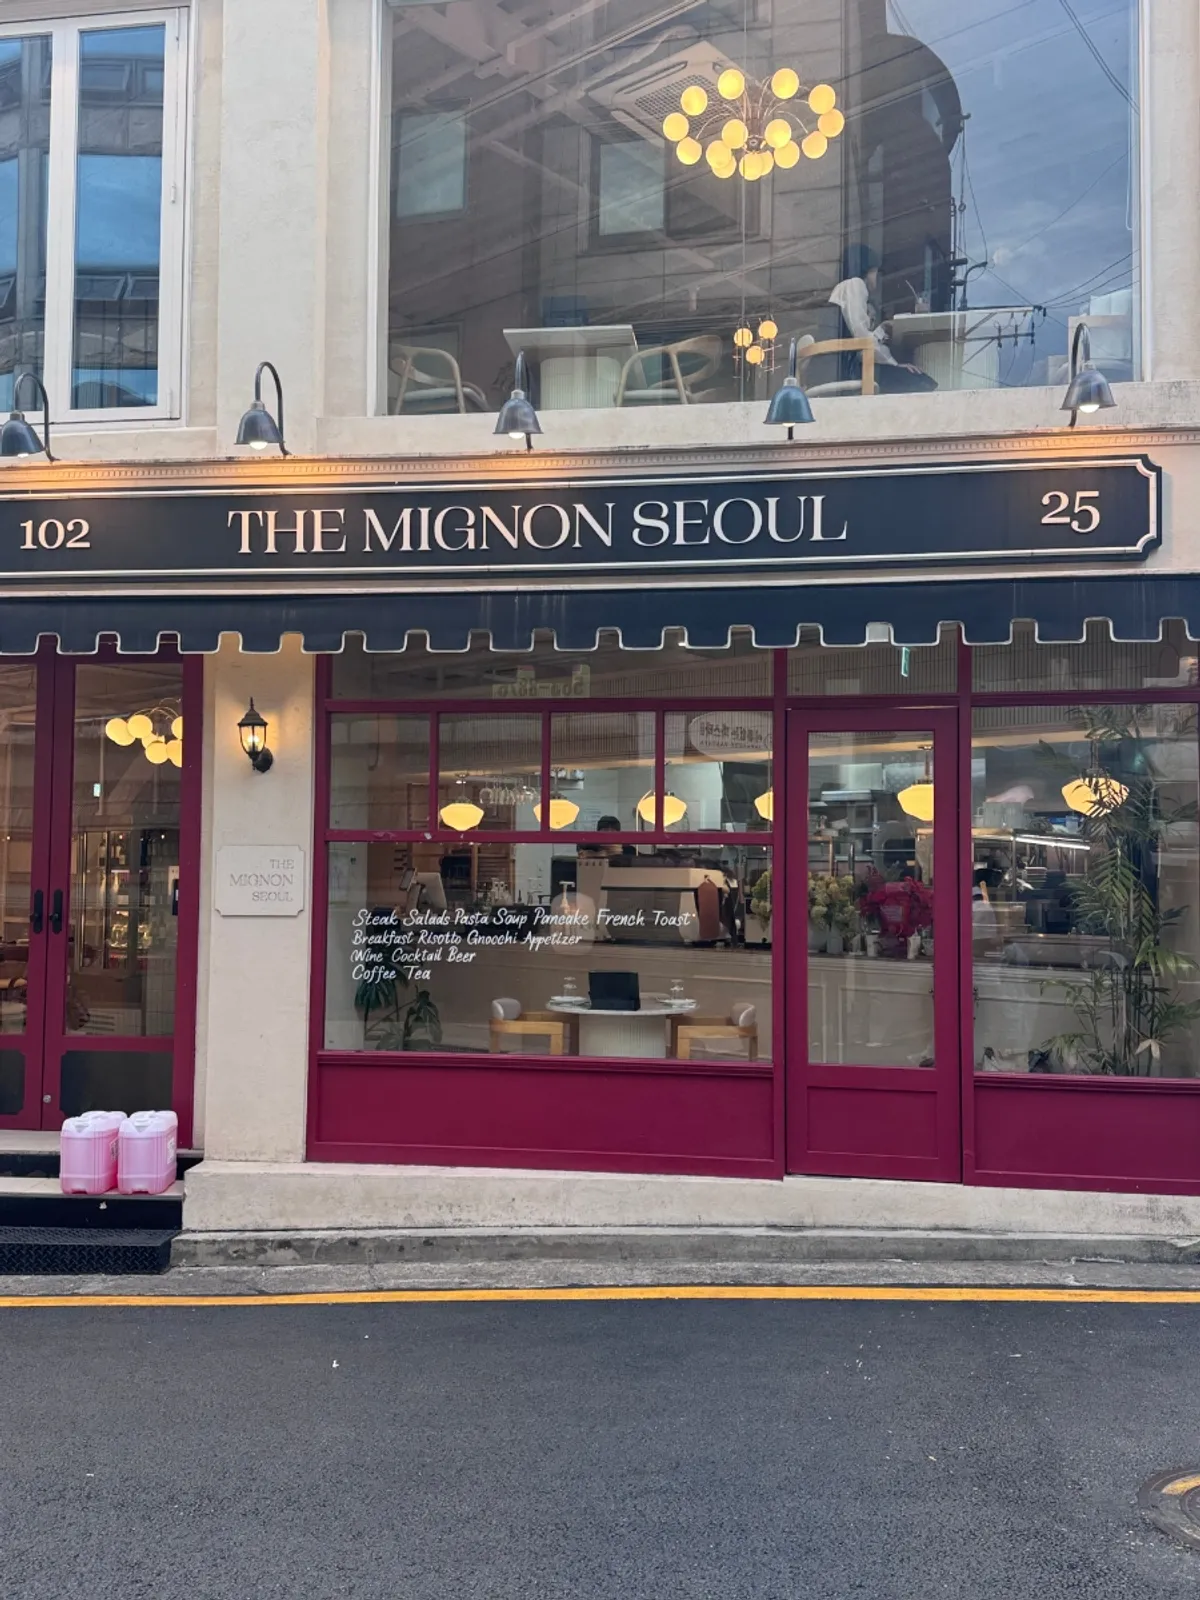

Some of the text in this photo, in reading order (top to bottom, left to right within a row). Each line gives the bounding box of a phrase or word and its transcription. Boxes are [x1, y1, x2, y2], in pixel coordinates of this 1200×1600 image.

[1040, 490, 1102, 534] 25
[20, 518, 91, 550] 102
[227, 494, 848, 554] THE MIGNON SEOUL
[269, 858, 295, 869] THE
[229, 873, 294, 887] MIGNON
[251, 891, 294, 902] SEOUL
[352, 907, 691, 928] Steak Salads Pasta Soup Pancake French Toast
[352, 929, 583, 952] Breakfast Risotto Gnocchi Appetizer
[350, 946, 476, 963] Wine Cocktail Beer
[352, 964, 431, 983] Coffee Tea
